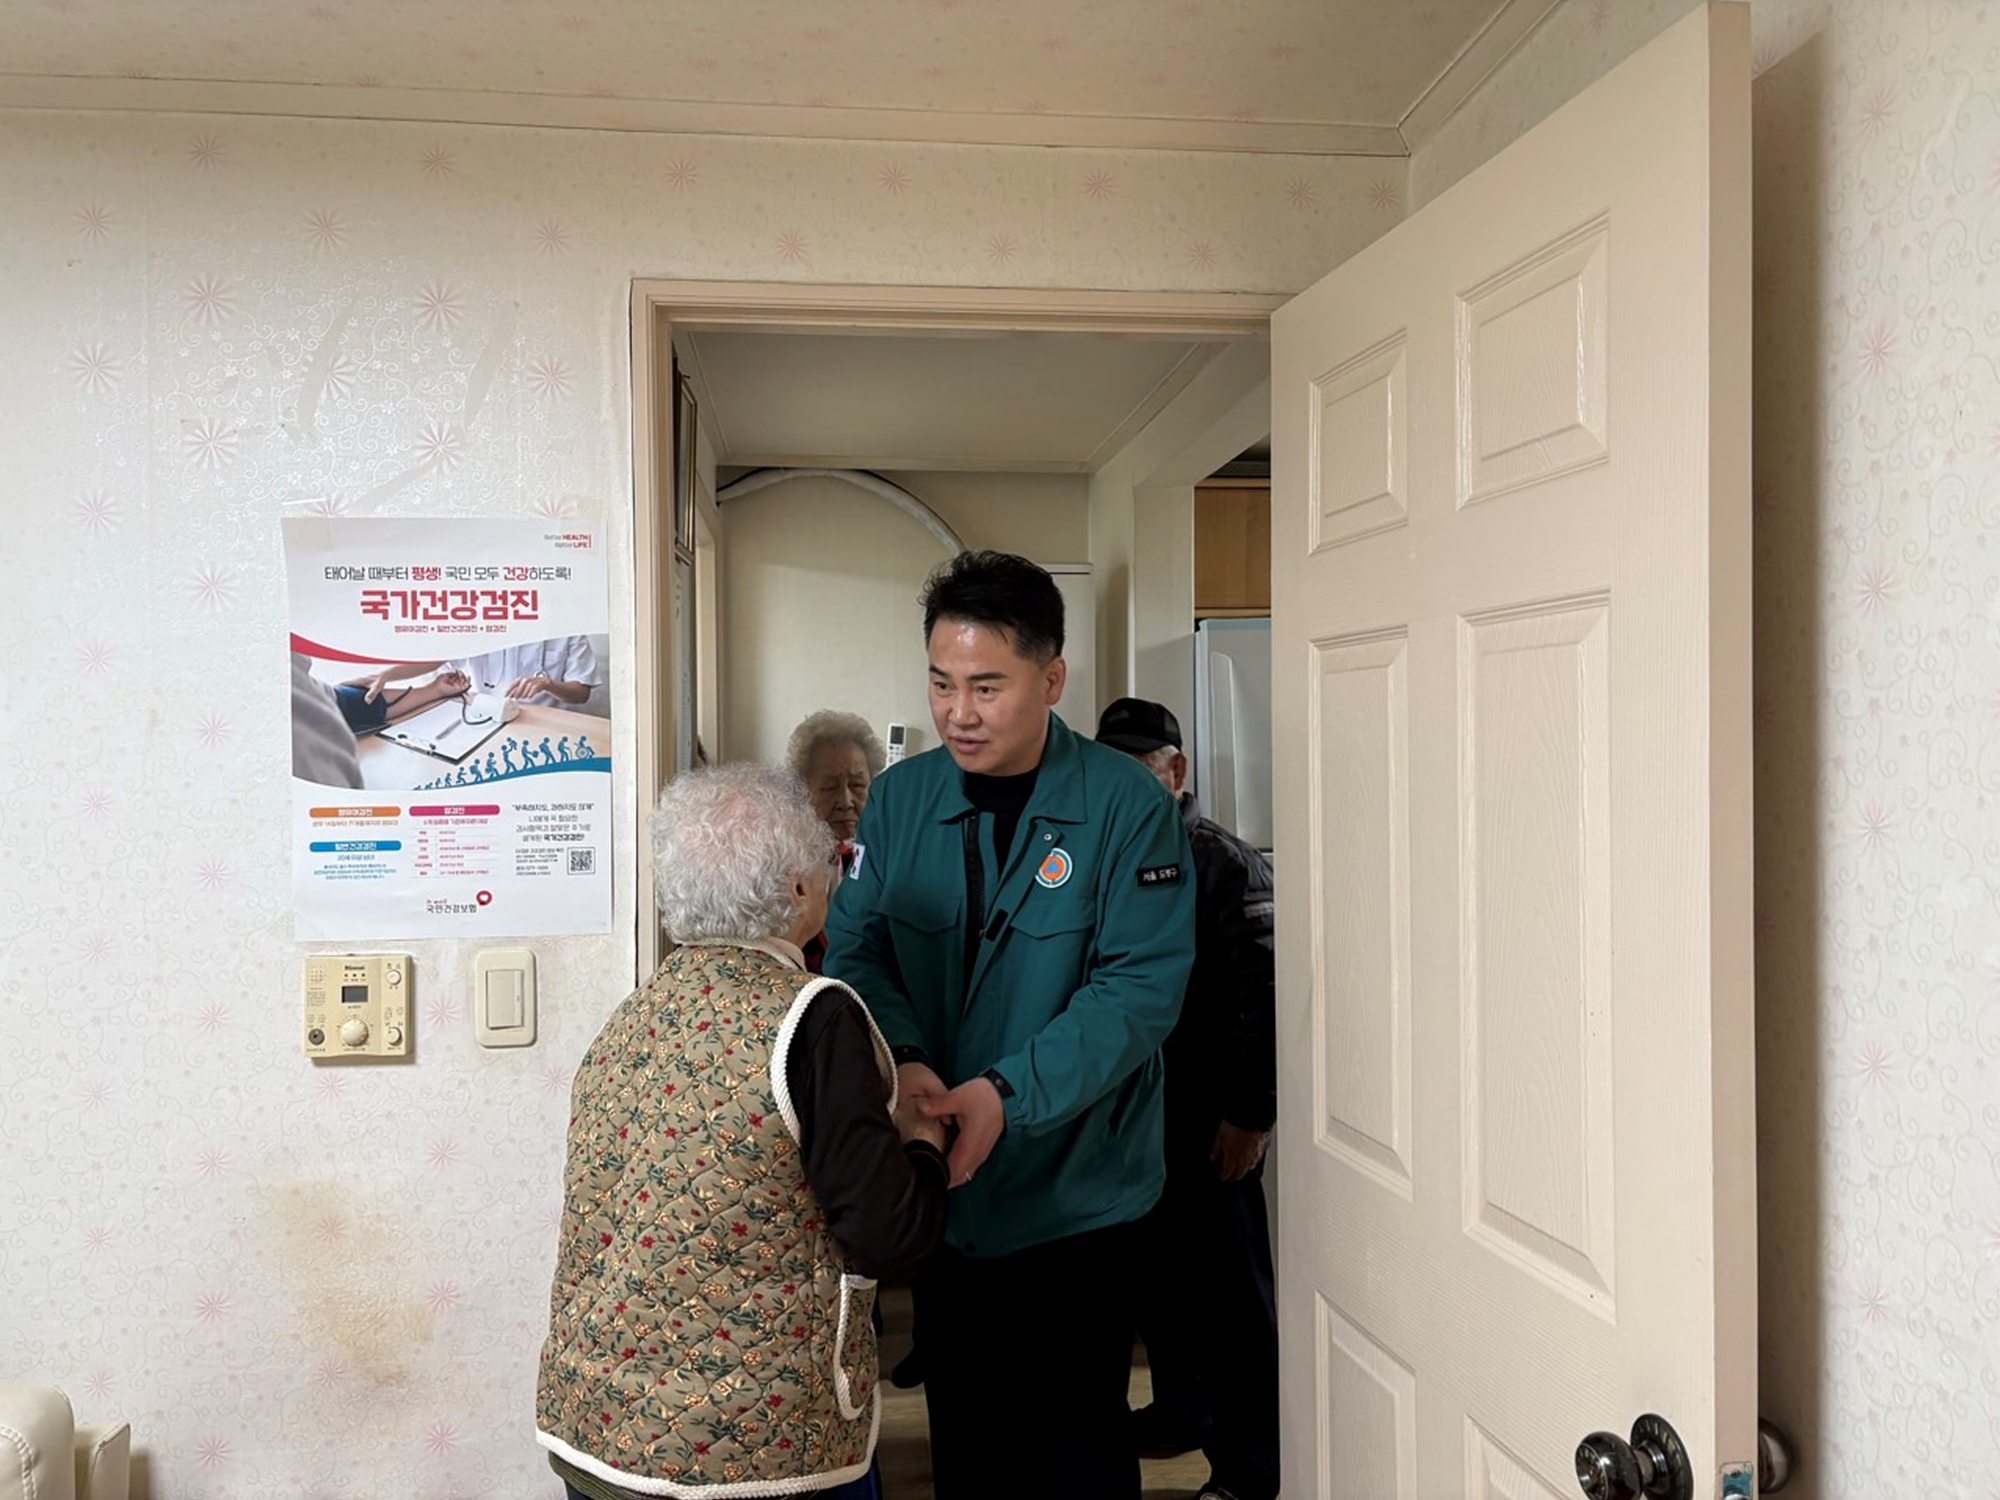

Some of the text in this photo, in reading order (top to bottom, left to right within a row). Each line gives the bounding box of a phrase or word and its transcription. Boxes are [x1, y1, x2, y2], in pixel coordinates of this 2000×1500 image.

[573, 541, 588, 549] LIFE
[324, 566, 571, 581] 태어날 때부터 평생! 국민 모두 건강하도록!
[360, 589, 538, 620] 국가건강검진
[1143, 867, 1178, 882] 서울 도봉구
[426, 904, 477, 914] 국민건강보험
